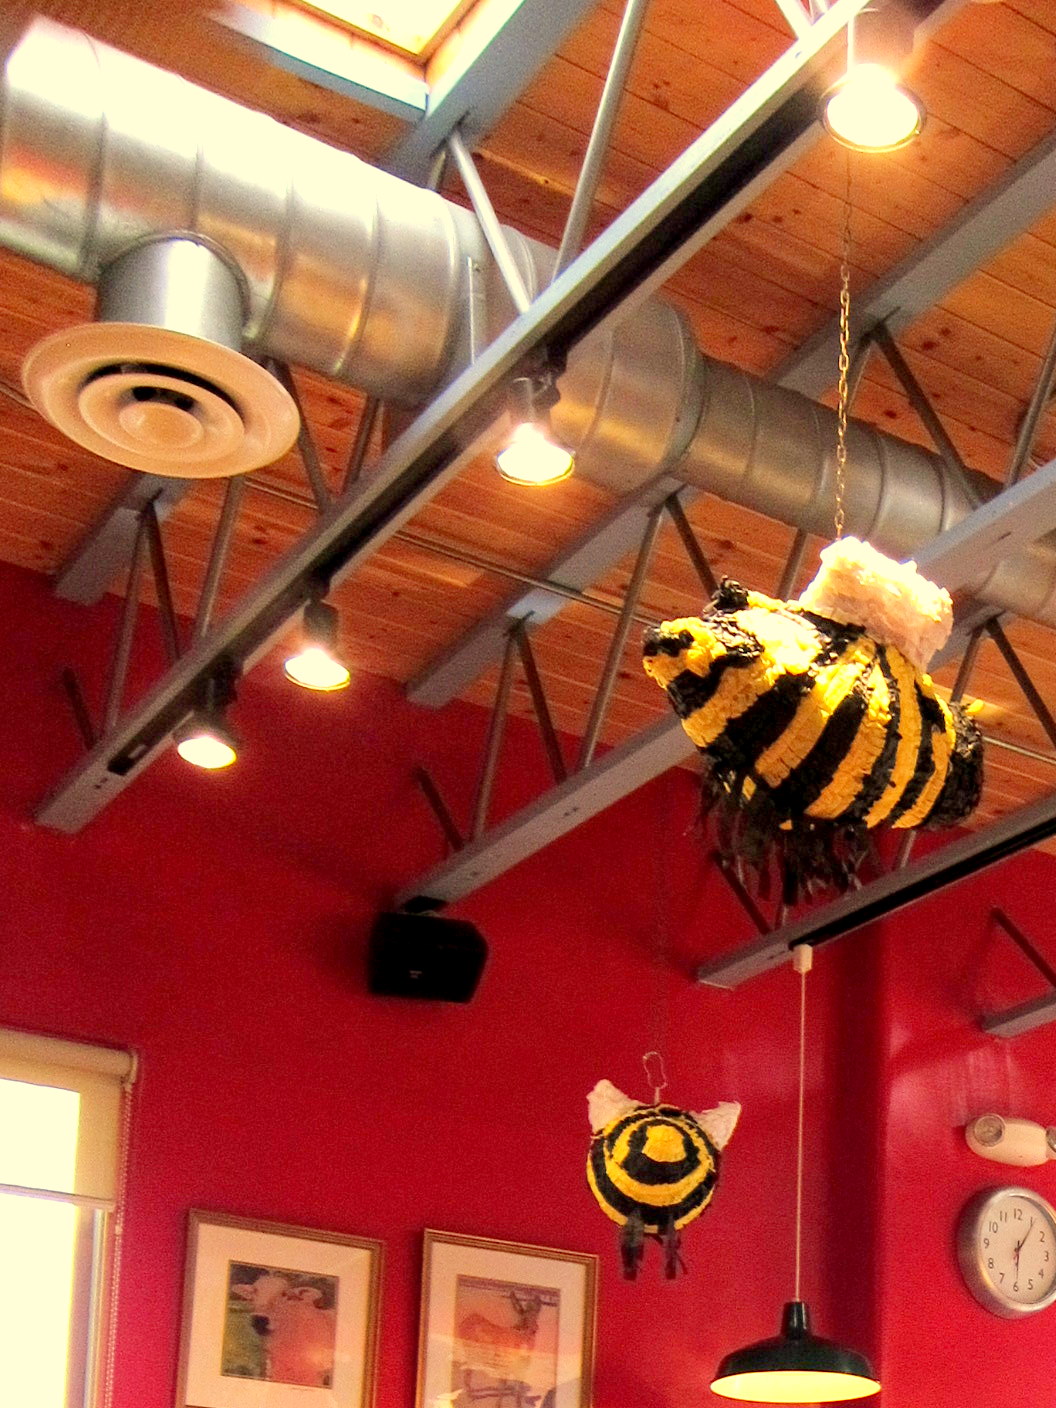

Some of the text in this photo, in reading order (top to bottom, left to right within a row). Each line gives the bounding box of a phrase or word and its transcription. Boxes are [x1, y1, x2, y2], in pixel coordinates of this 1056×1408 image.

[999, 1210, 1008, 1223] 11
[1013, 1208, 1023, 1221] 12
[988, 1221, 999, 1234] 10
[1039, 1231, 1046, 1243] 2
[983, 1238, 990, 1249] 9
[1044, 1250, 1050, 1262] 3
[987, 1257, 995, 1269] 8
[999, 1272, 1005, 1284] 7
[1038, 1268, 1044, 1279] 4
[1012, 1281, 1019, 1292] 6
[1027, 1278, 1034, 1290] 5
